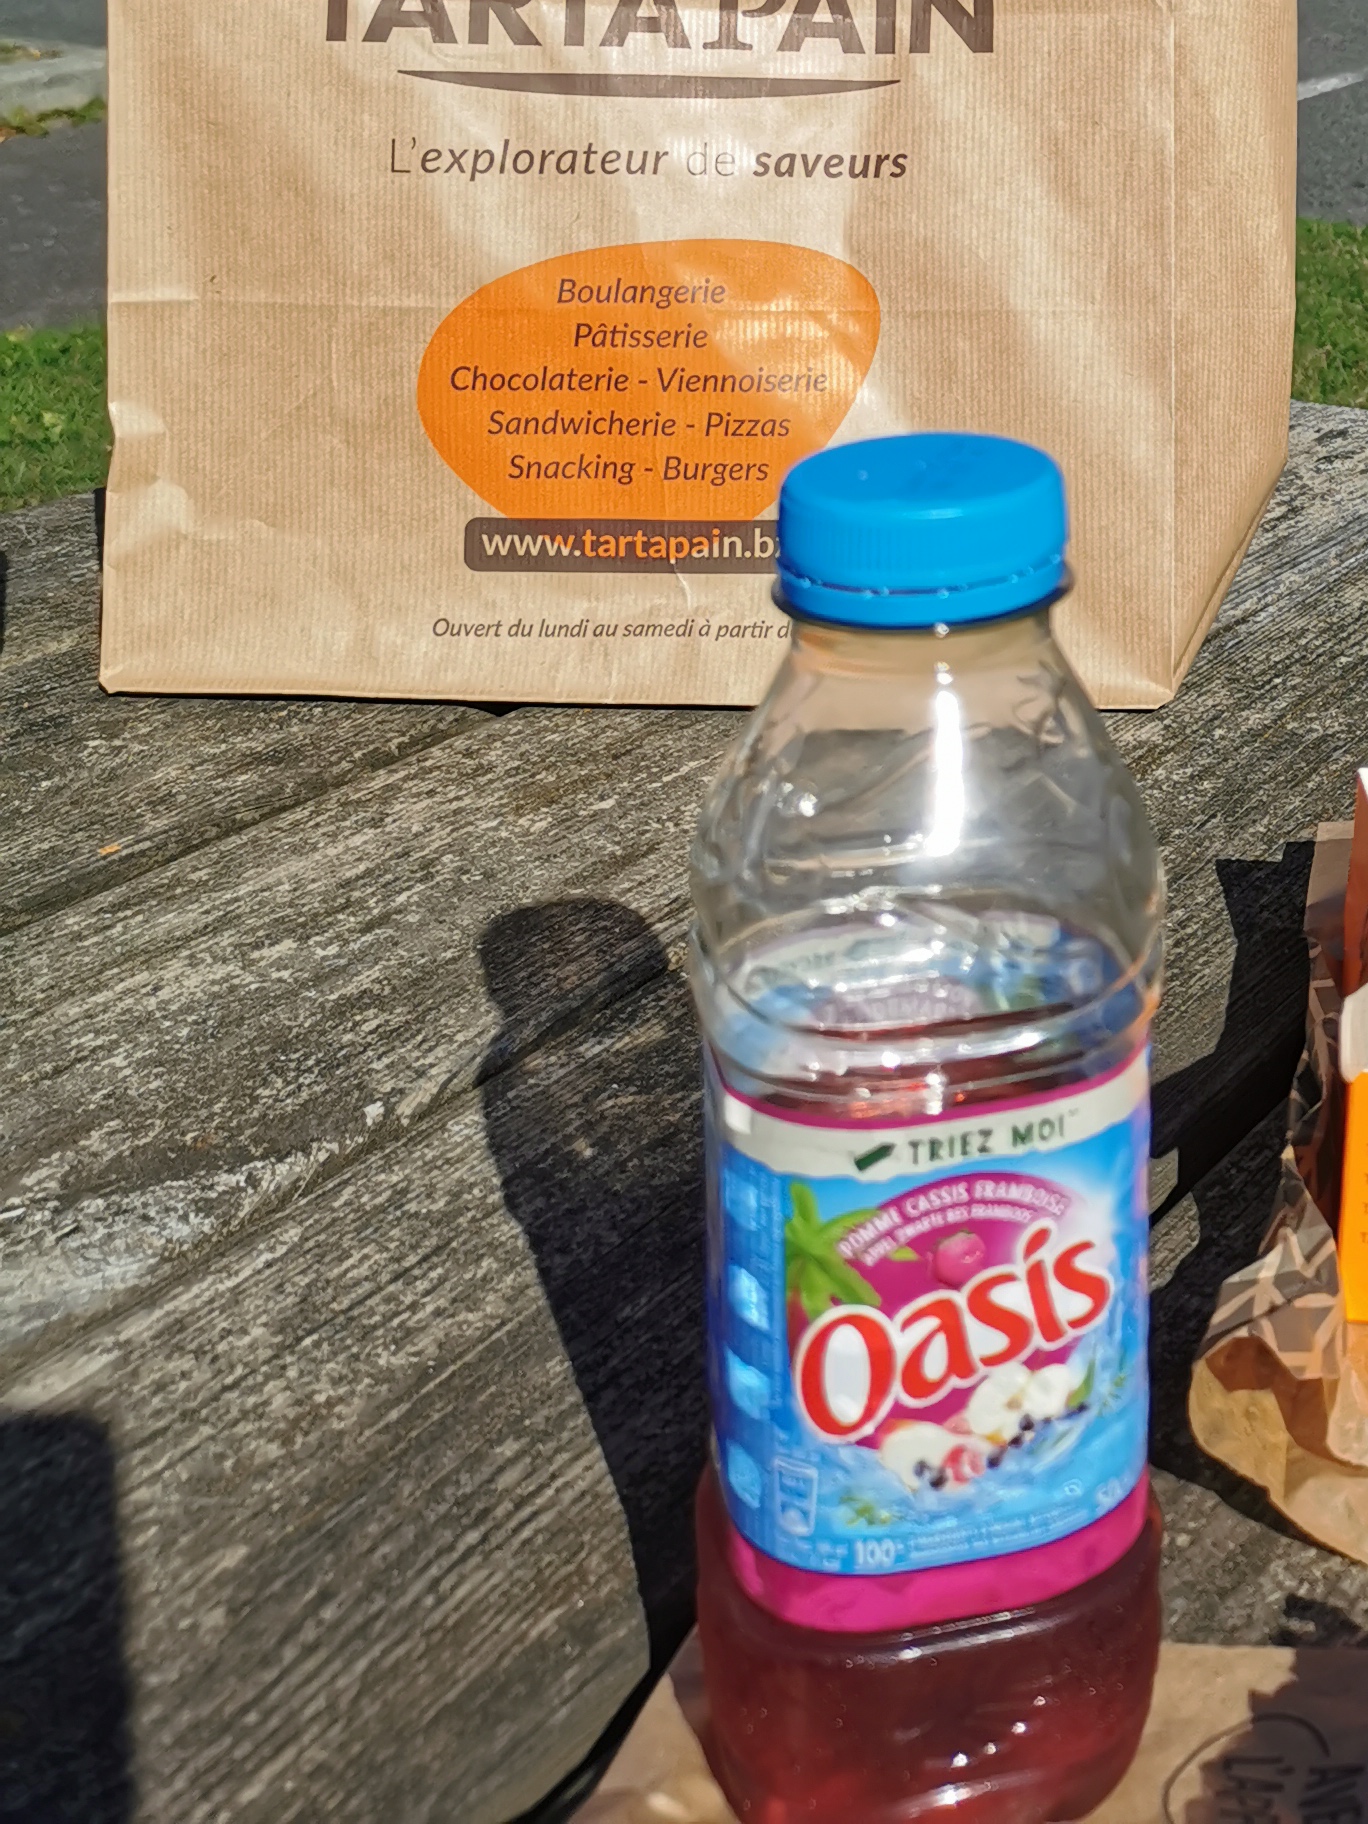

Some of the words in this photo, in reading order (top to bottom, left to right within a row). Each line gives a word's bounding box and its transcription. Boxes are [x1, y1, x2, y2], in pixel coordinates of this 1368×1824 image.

[686, 142, 738, 177] de
[752, 149, 908, 179] saveurs
[556, 278, 726, 309] Boulangerie
[573, 322, 708, 348] Pâtisserie
[450, 366, 630, 392] Chocolaterie
[657, 367, 828, 393] Viennoiserie
[487, 409, 677, 437] Sandwicherie
[704, 412, 792, 437] Pizzas
[508, 453, 636, 485] Snacking
[662, 456, 769, 486] Burgers
[482, 528, 780, 564] www.tartapain.b
[432, 618, 502, 639] Ouvert
[507, 619, 534, 639] du
[538, 618, 590, 639] lundi
[593, 624, 619, 639] au
[622, 618, 693, 639] samedi
[699, 619, 711, 638] à
[715, 620, 774, 642] partir
[908, 1128, 993, 1165] TRIEZ
[837, 1206, 902, 1259] POMME
[905, 1182, 971, 1218] CASSIS
[973, 1180, 1070, 1217] FRAMBOISE
[800, 1220, 1111, 1440] Oasis
